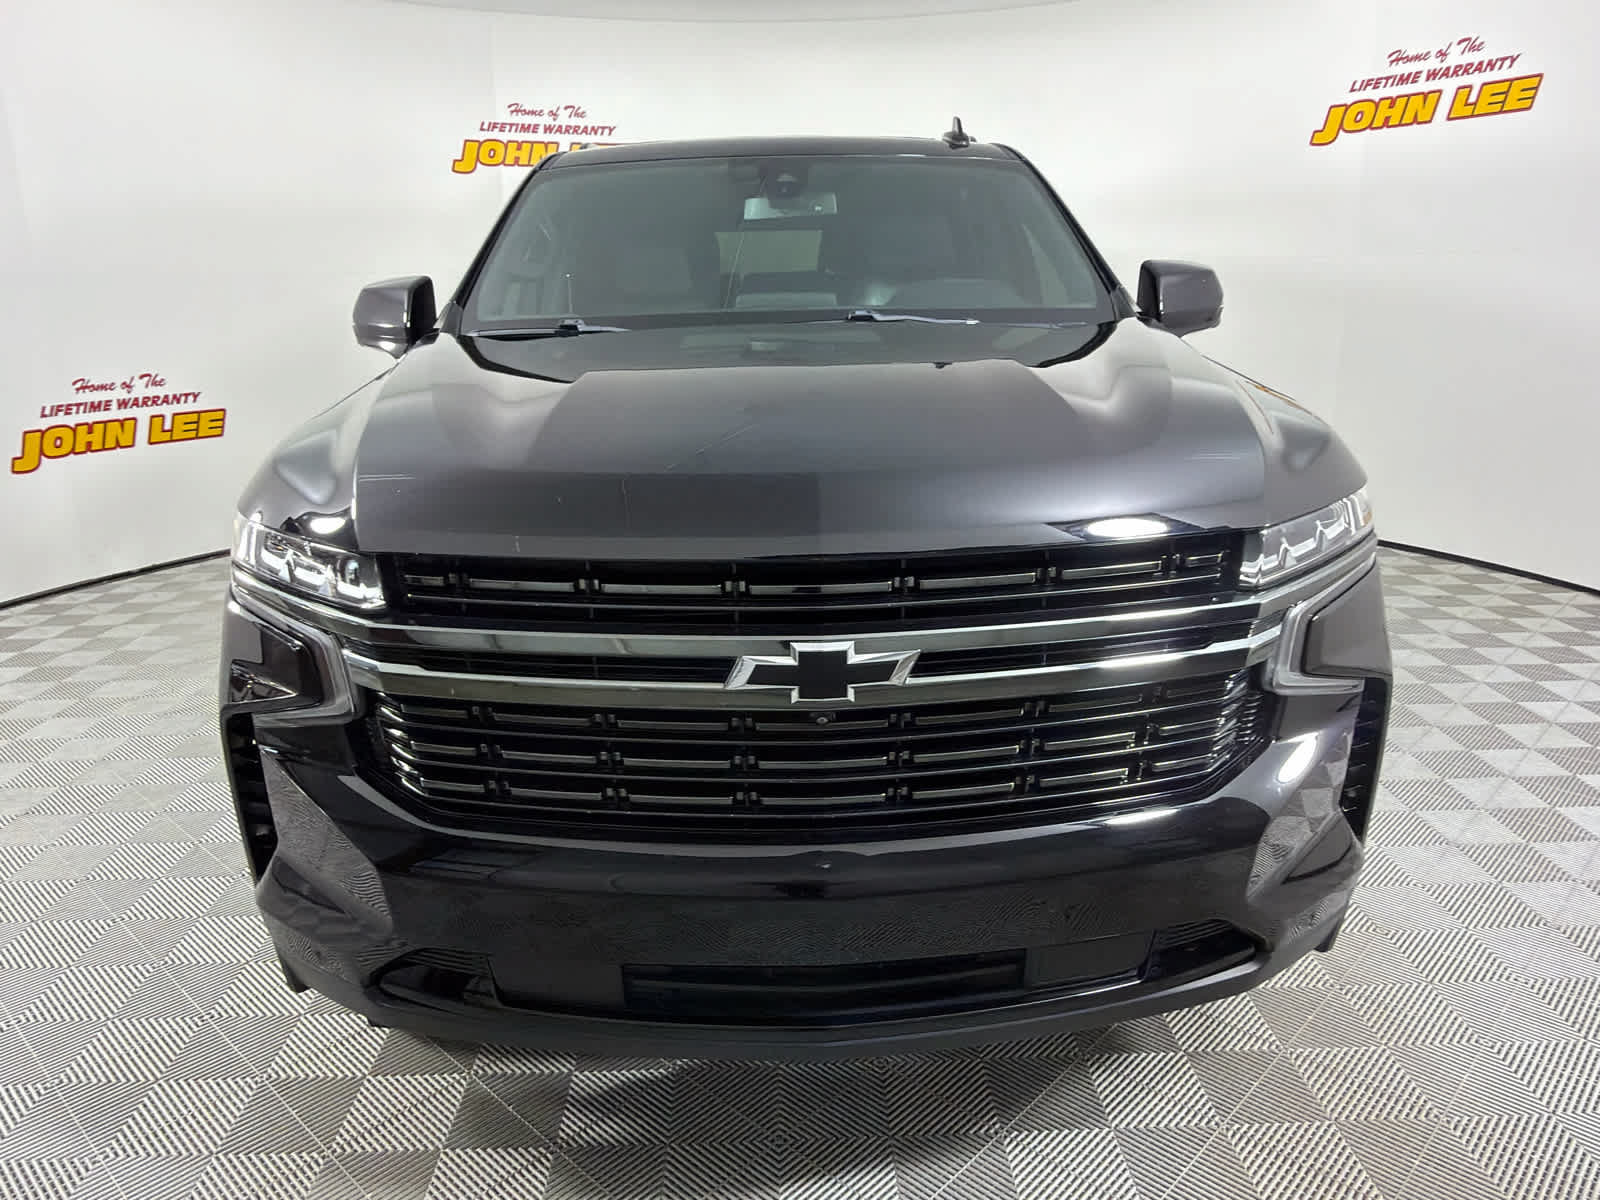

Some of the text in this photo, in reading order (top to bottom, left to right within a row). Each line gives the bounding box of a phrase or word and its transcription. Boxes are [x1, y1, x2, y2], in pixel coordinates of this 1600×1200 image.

[1387, 36, 1486, 67] Home of The
[1350, 54, 1521, 92] LIFETIME WARRANTY
[507, 103, 587, 121] Home of The
[1310, 73, 1544, 145] JOHN LEE
[479, 121, 616, 137] LIFETIME WARRANTY
[72, 373, 166, 394] Home of The
[40, 392, 202, 418] LIFETIME WARRANTY
[11, 408, 226, 474] JOHN LEE
